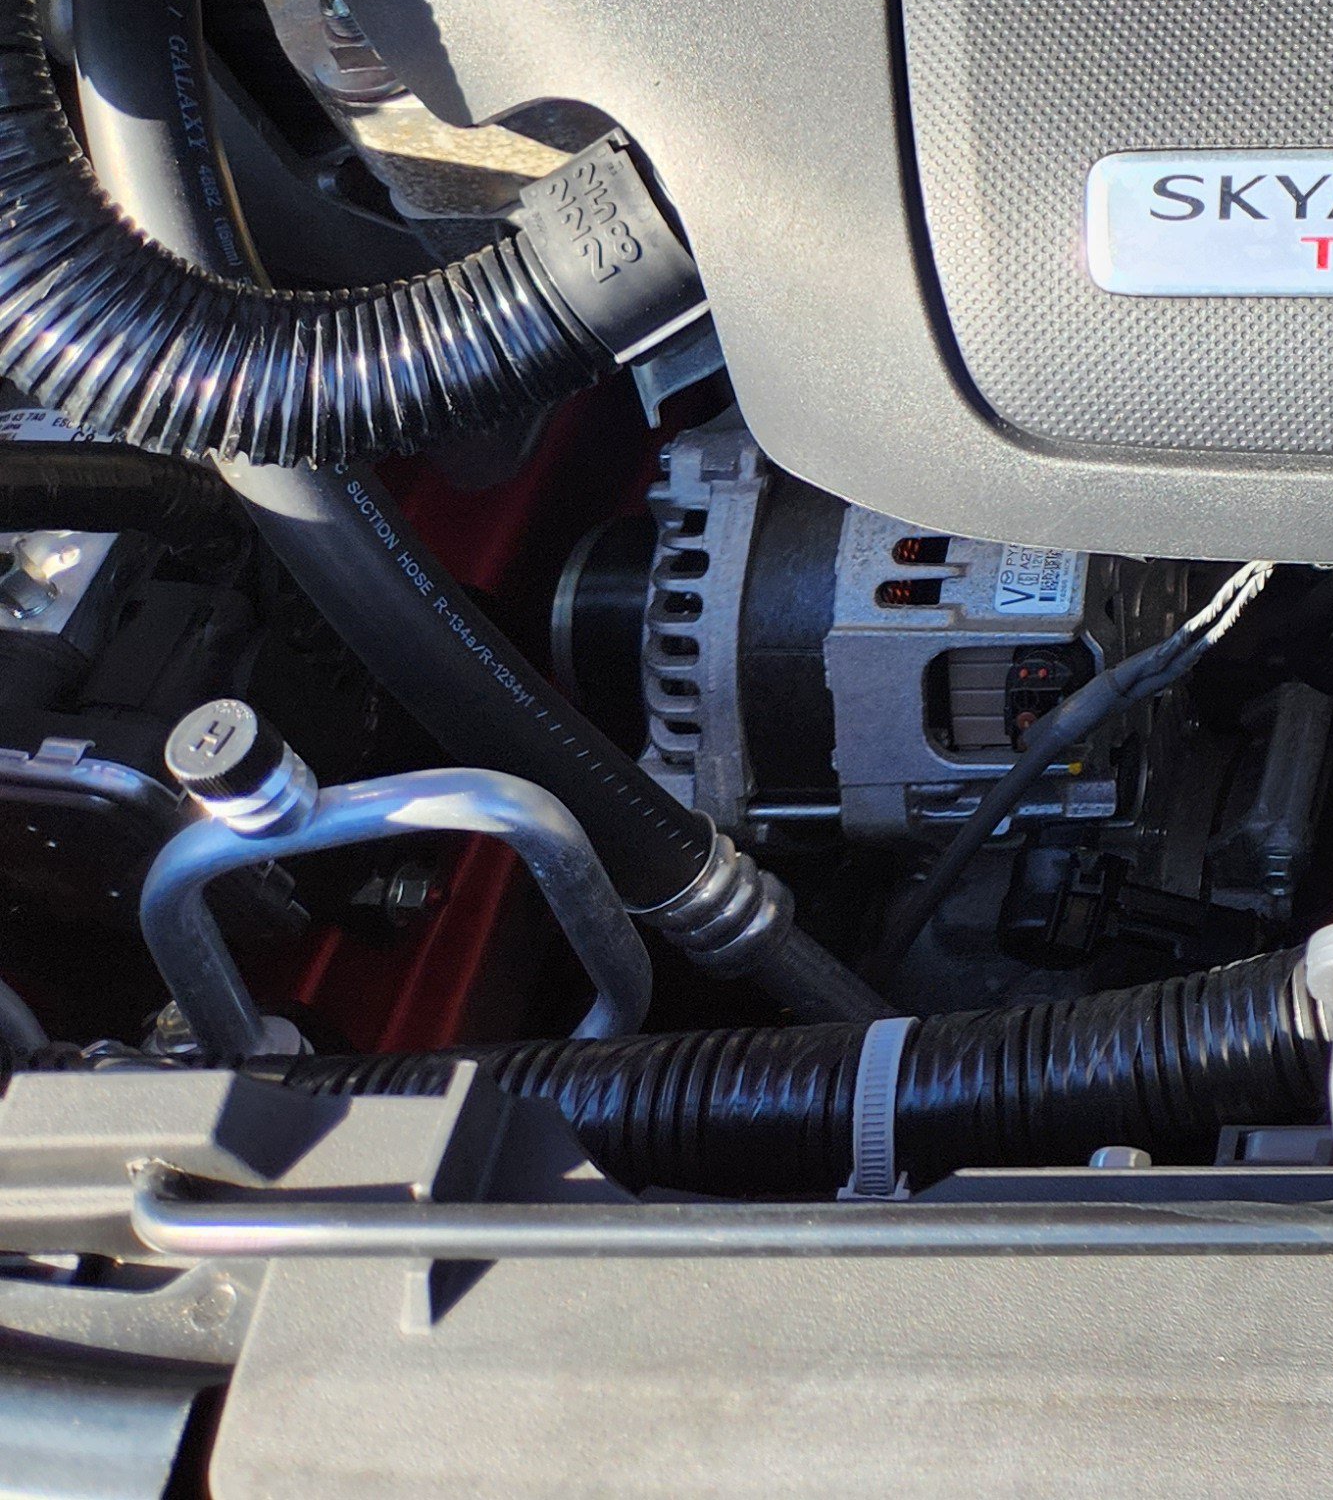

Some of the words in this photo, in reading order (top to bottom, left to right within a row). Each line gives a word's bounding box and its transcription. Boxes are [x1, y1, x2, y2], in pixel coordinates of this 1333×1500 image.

[168, 34, 209, 153] GALAXY
[347, 480, 400, 549] SUCTION
[397, 551, 434, 596] HOSE
[1000, 586, 1035, 606] V
[189, 720, 236, 758] H
